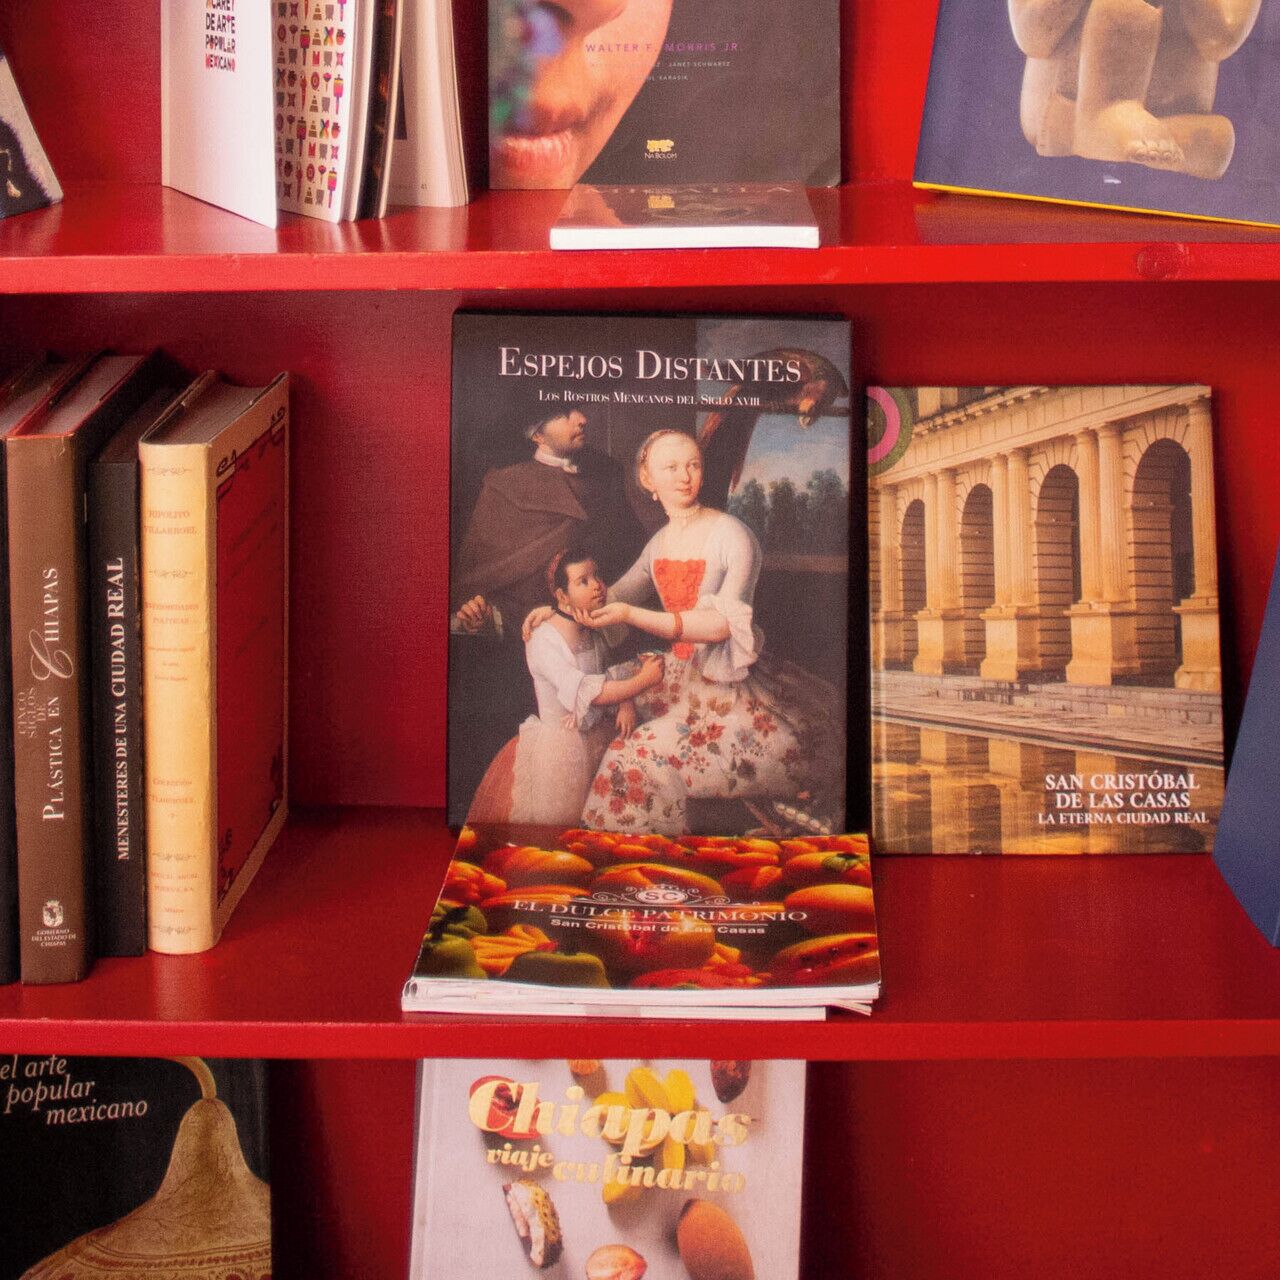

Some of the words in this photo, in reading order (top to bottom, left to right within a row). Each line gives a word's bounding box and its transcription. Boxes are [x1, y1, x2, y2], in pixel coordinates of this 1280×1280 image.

[205, 12, 216, 31] DE
[216, 13, 236, 34] ARTE
[205, 53, 236, 73] MEXICANO
[498, 346, 623, 380] ESPEJOS
[635, 349, 802, 383] DISTANTES
[538, 389, 560, 402] LOS
[563, 390, 610, 403] ROSTROS
[613, 391, 674, 405] MEXICANOS
[676, 394, 698, 405] DEL
[700, 393, 733, 406] SIGLO
[106, 557, 125, 619] REAL
[28, 566, 74, 681] CHIAPAS
[110, 623, 127, 698] CIUDAD
[47, 696, 61, 718] EN
[114, 702, 127, 735] UNA
[115, 739, 128, 758] DE
[42, 726, 65, 821] PLÁSTICA
[1045, 773, 1084, 790] SAN
[1090, 770, 1200, 790] CRISTÓBAL
[115, 760, 130, 862] MENESTERES
[1056, 792, 1083, 809] DE
[1088, 792, 1125, 809] LAS
[1129, 792, 1192, 809] CASAS
[1038, 812, 1055, 825] LA
[1059, 812, 1113, 825] ETERNA
[1116, 812, 1171, 825] CIUDAD
[1174, 812, 1210, 824] REAL
[644, 890, 680, 902] SC
[512, 899, 546, 913] EL
[550, 902, 636, 919] DULCE
[642, 908, 809, 922] PATRIMONIO
[549, 918, 584, 928] San
[660, 923, 679, 933] de
[717, 925, 766, 935] Casas
[25, 1056, 68, 1078] arte
[4, 1074, 96, 1114] popular
[46, 1099, 149, 1126] mexicano
[467, 1080, 754, 1157] Chiapas
[487, 1143, 554, 1173] viaje
[552, 1152, 747, 1194] culinario
